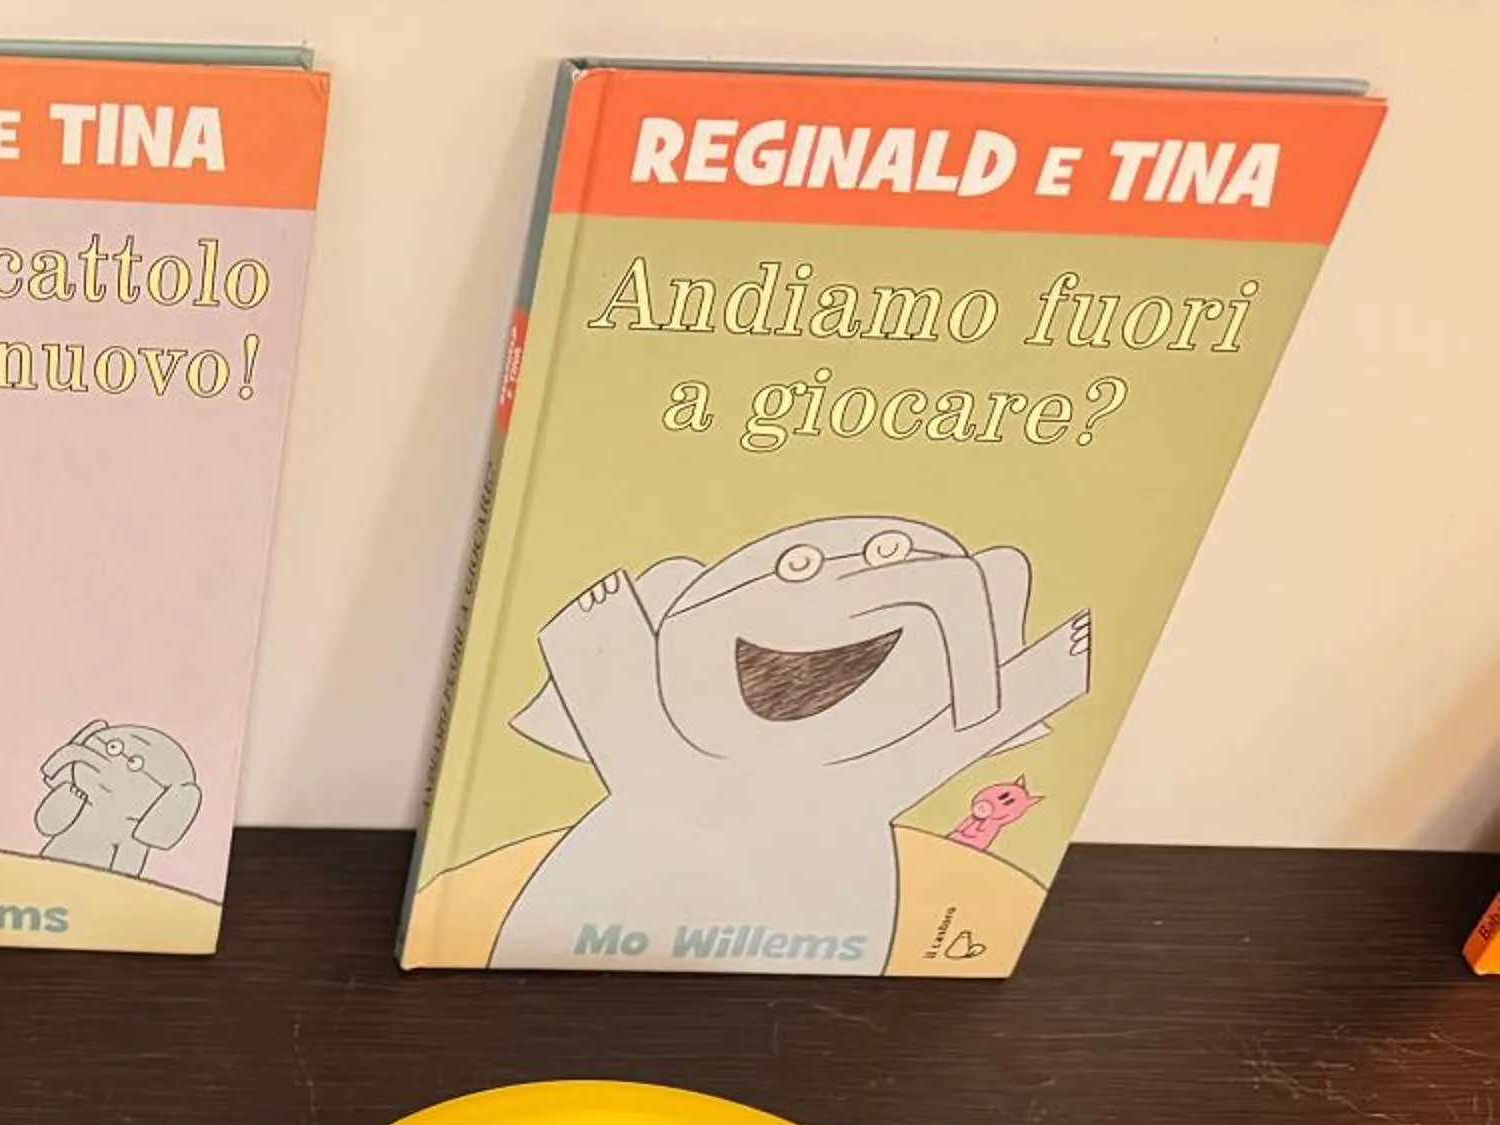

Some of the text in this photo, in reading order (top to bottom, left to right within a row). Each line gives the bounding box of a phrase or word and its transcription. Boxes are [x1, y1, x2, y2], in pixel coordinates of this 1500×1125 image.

[50, 104, 225, 171] TINA
[631, 118, 1281, 207] REGINALD E TINA
[588, 256, 1260, 354] Andiamo fuori
[663, 367, 1126, 453] a giocare?
[572, 922, 868, 962] Mo Willems
